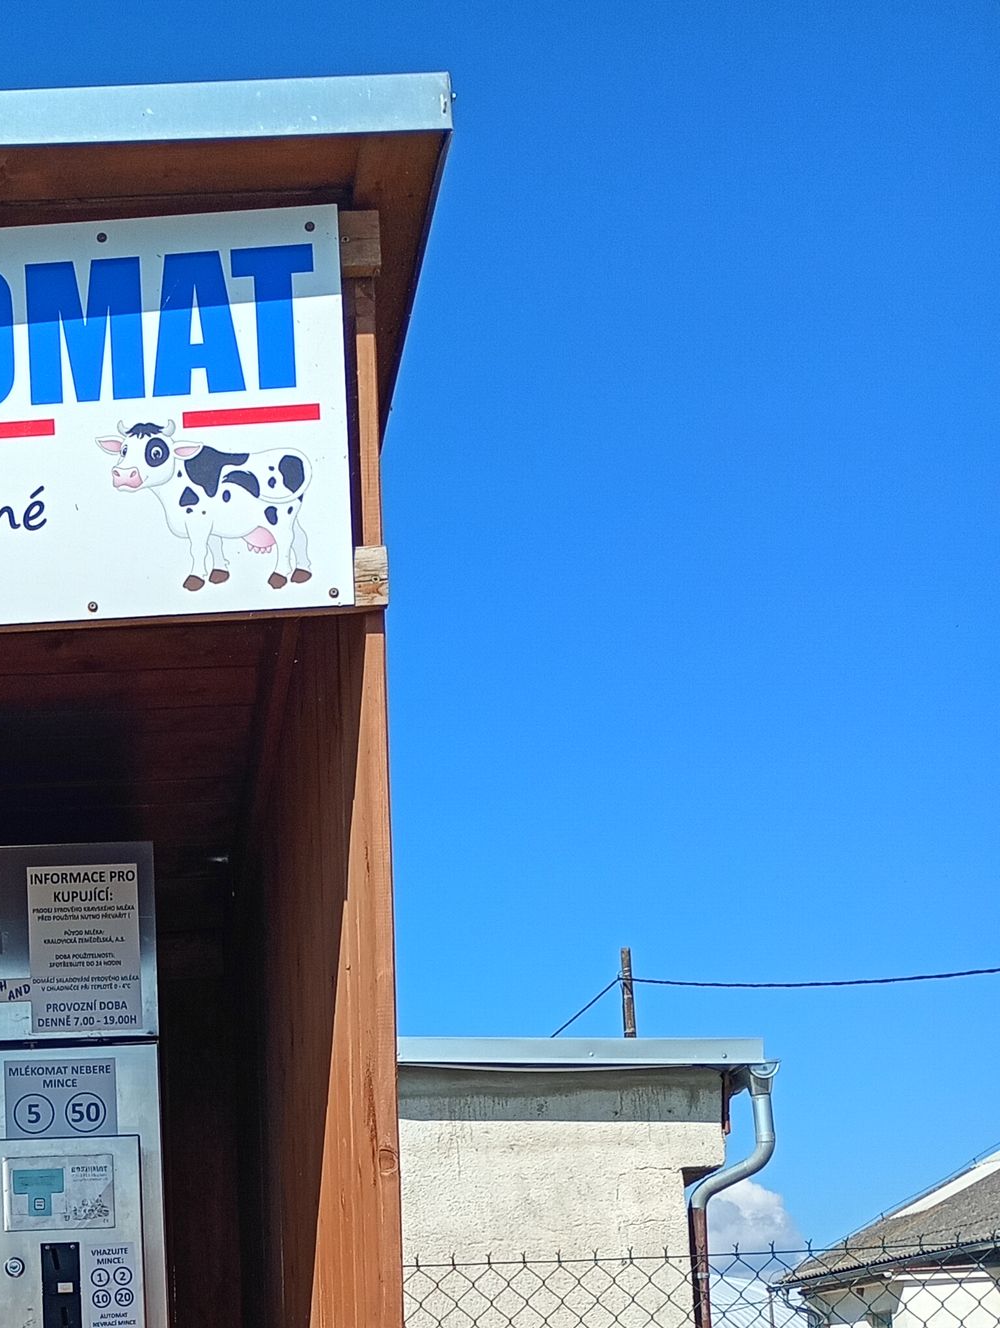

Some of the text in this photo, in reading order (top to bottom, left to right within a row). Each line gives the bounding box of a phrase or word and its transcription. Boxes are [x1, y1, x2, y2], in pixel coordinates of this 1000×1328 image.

[30, 870, 136, 885] INFORMACE PRO
[53, 887, 113, 902] KUPUJÍCÍ:
[8, 983, 31, 1001] AND
[46, 1000, 127, 1012] PROVOZNÍ DOBA
[37, 1015, 71, 1027] DENNĚ
[74, 1017, 94, 1026] 7.00
[103, 1015, 137, 1025] 19.00H
[8, 1064, 111, 1078] MLÉKOMAT NEBERE
[42, 1078, 78, 1089] MINCE
[27, 1103, 100, 1123] 5 50
[91, 1248, 129, 1257] VHAZUJTE
[96, 1257, 125, 1265] MINCE:
[97, 1272, 127, 1283] 1 2
[95, 1292, 131, 1304] 10 20
[92, 1319, 117, 1328] NEVRACÍ
